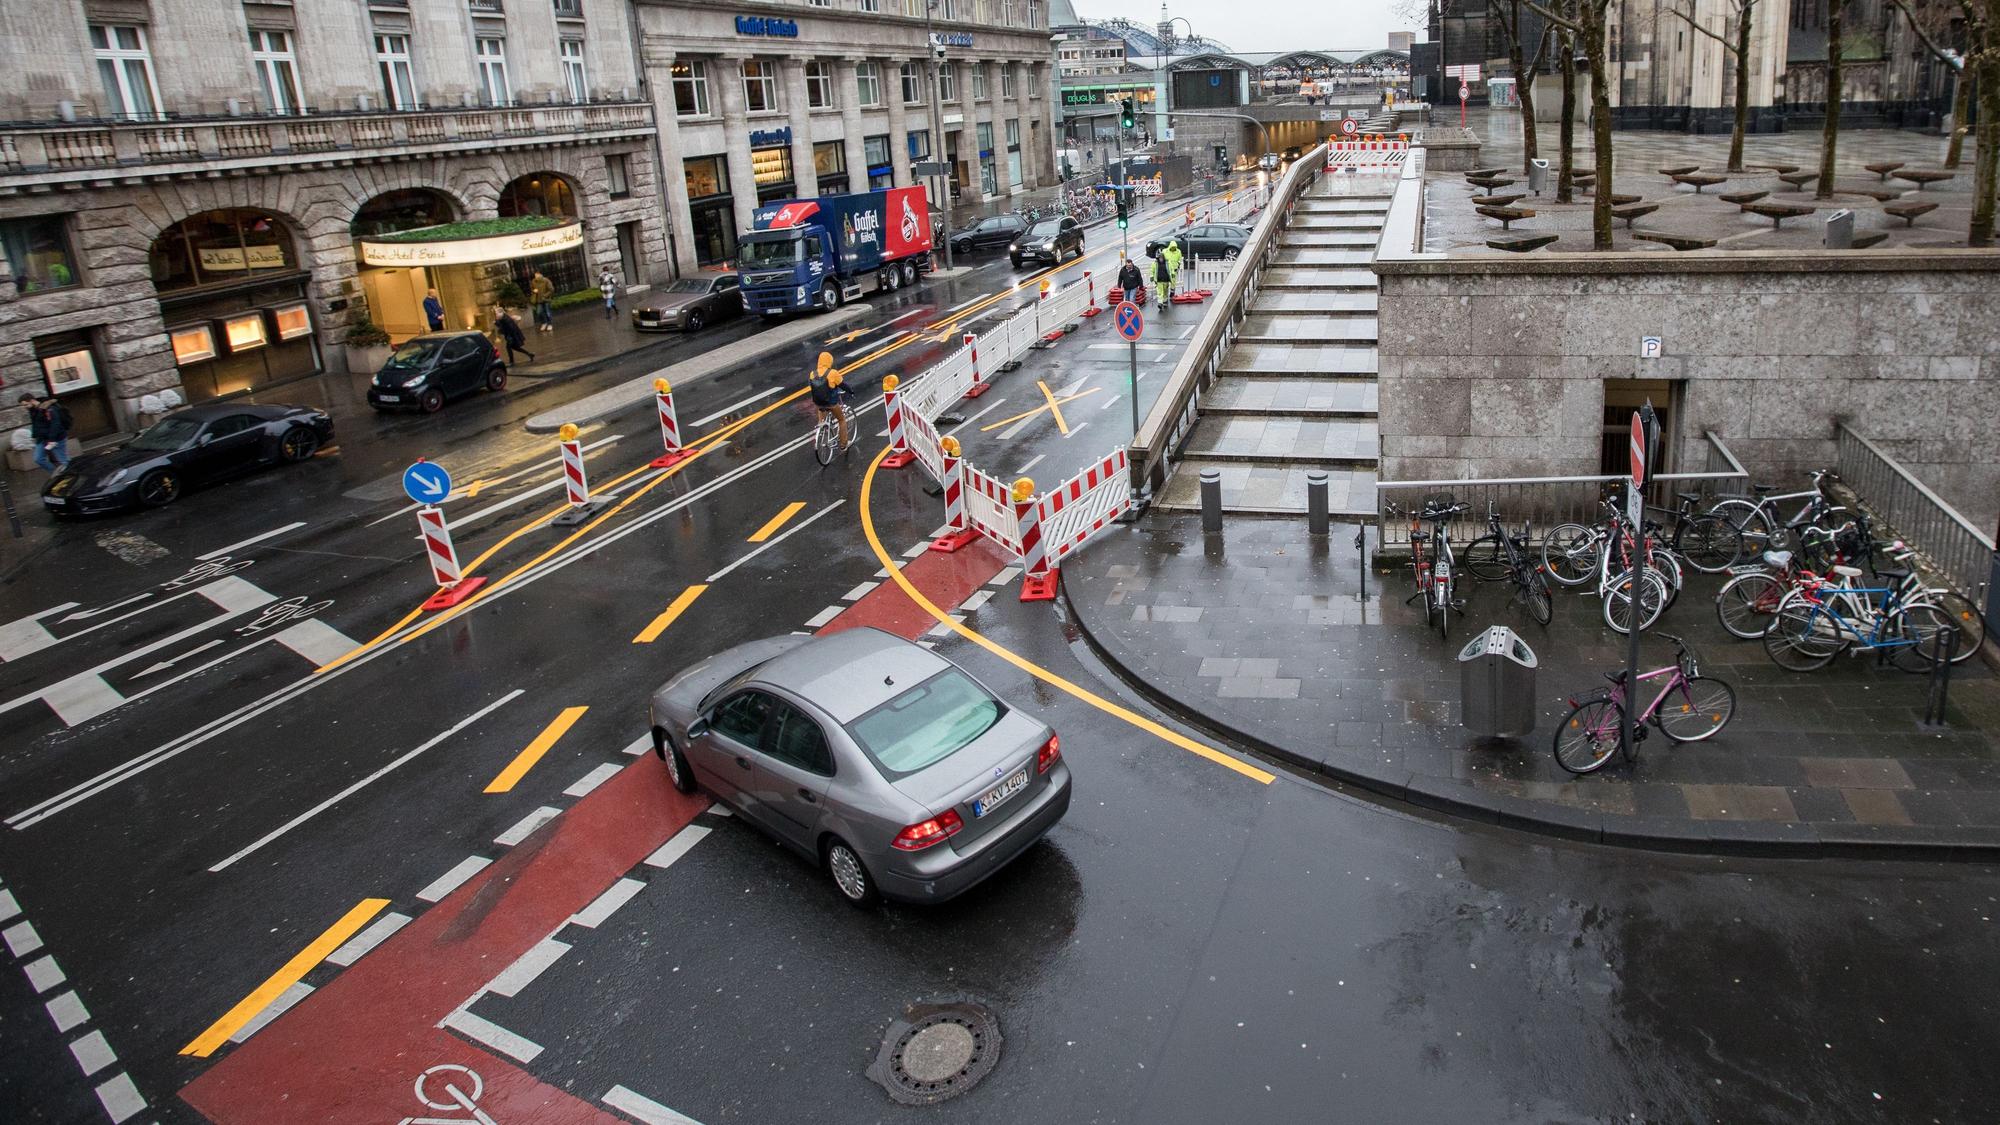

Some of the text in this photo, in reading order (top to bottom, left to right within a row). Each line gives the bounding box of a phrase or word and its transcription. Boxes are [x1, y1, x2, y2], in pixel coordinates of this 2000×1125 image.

[1067, 94, 1097, 103] DOUGLAS
[854, 209, 879, 232] Gaffel
[1647, 342, 1657, 356] P
